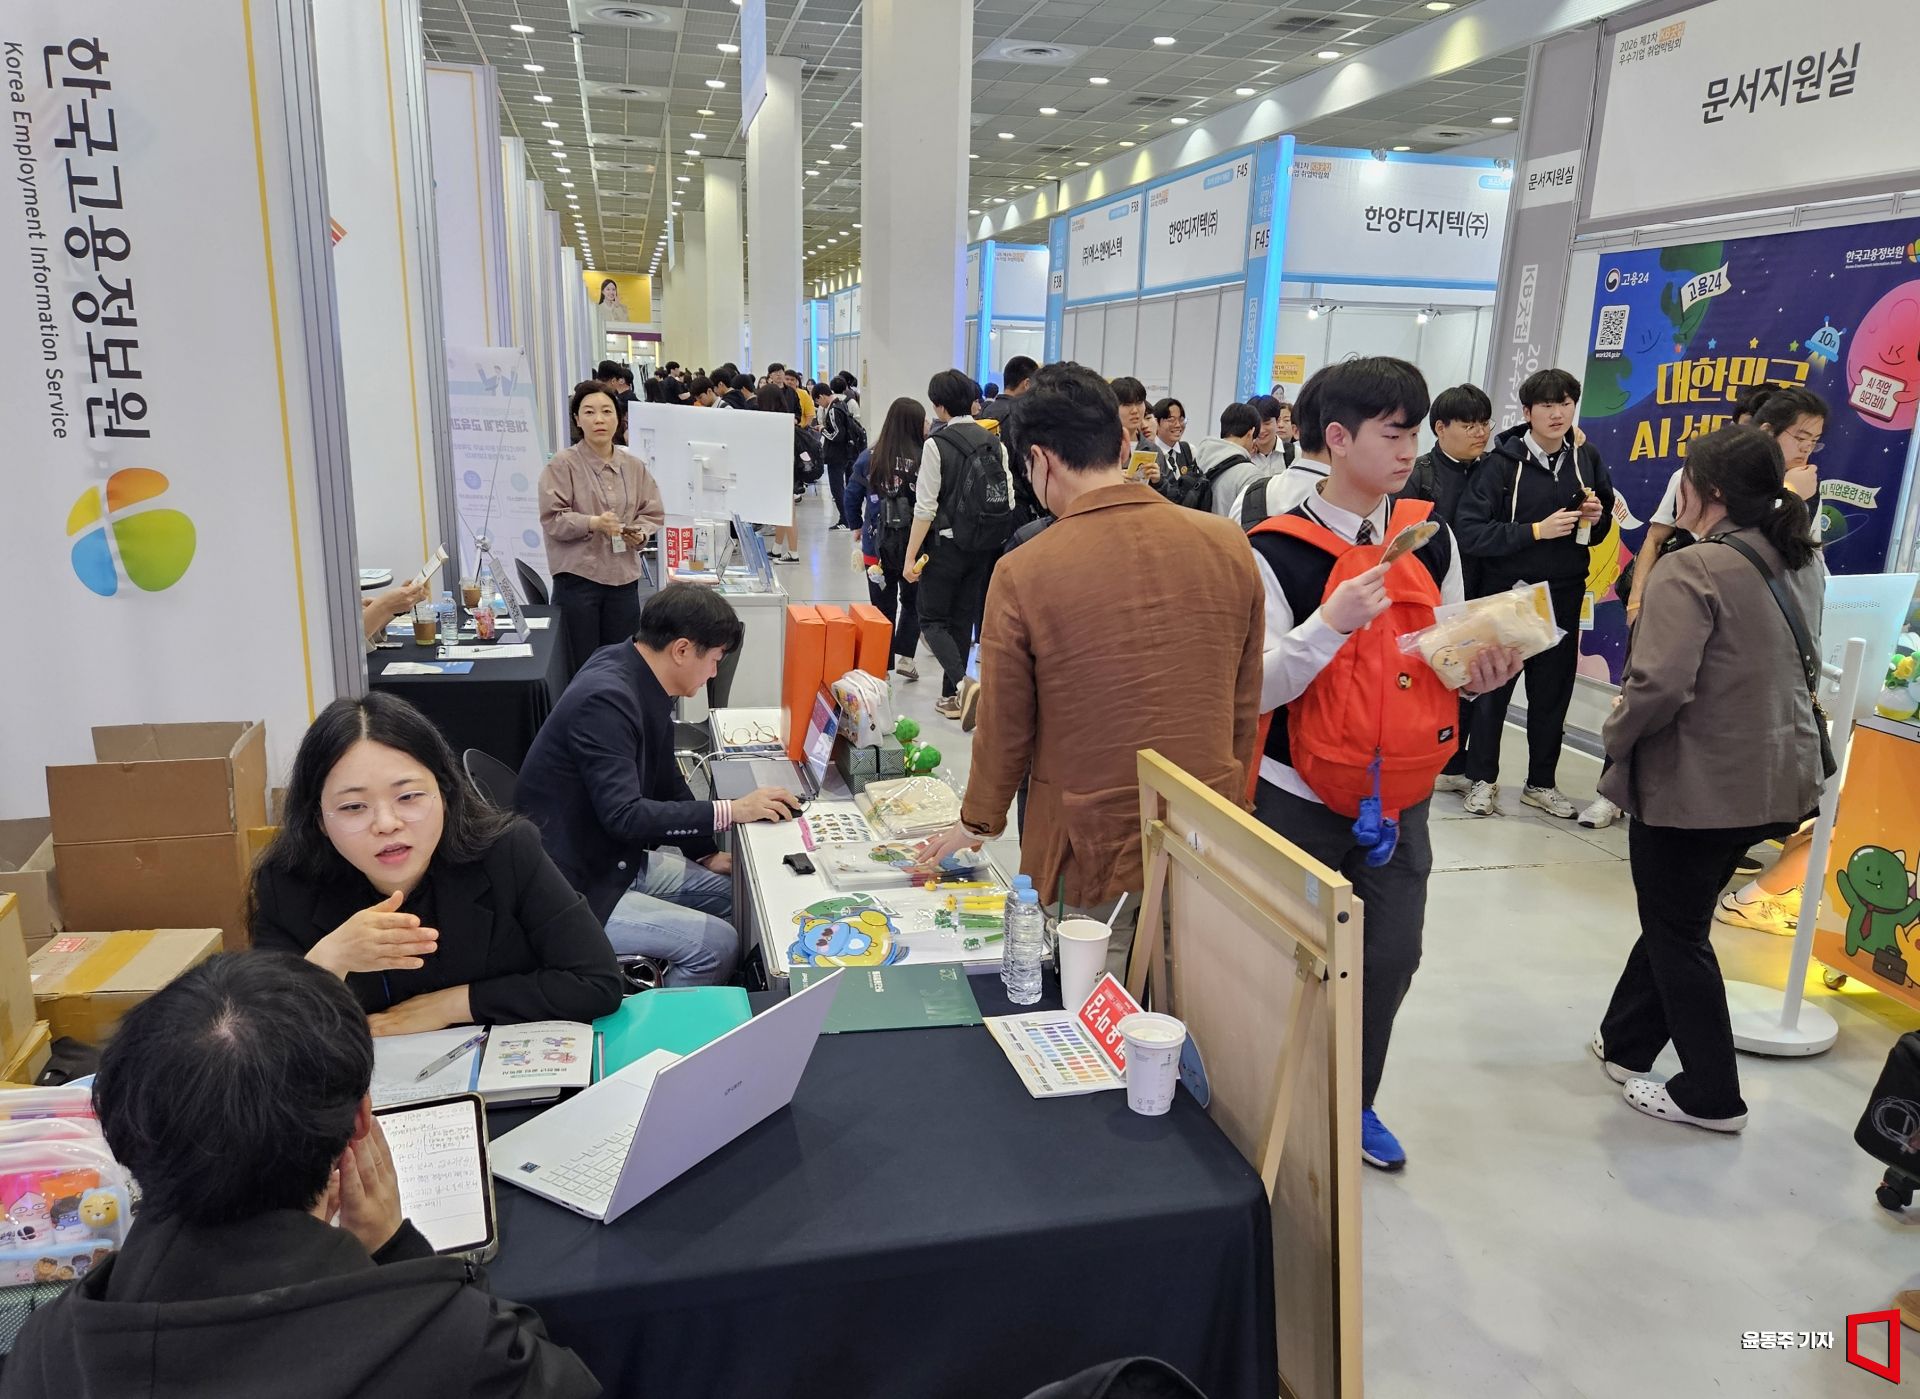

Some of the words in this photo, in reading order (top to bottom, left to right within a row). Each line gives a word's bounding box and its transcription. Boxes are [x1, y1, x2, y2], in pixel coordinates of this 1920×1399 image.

[1619, 40, 1638, 53] 2026
[1619, 48, 1646, 66] 우수기업
[1648, 37, 1682, 57] 취업박람회
[4, 41, 25, 103] Korea
[1701, 42, 1861, 125] 문서지원실
[12, 110, 45, 240] Employment
[1236, 162, 1248, 179] F45
[1528, 165, 1575, 191] 문서지원실
[43, 37, 151, 438] 한국고용정보원
[1169, 209, 1219, 245] 한양디지텍(주)
[1364, 205, 1489, 239] 한양디지텍(주)
[1255, 230, 1270, 250] F45
[1846, 246, 1905, 263] 한국고용정보원
[1621, 271, 1650, 287] 고용24
[1687, 272, 1722, 302] 고용24
[30, 245, 59, 361] Information
[1514, 266, 1536, 341] KB굿잡
[45, 368, 67, 440] Service
[1502, 348, 1525, 431] 우수기업
[1876, 379, 1893, 395] 직업
[1629, 417, 1672, 462] AI
